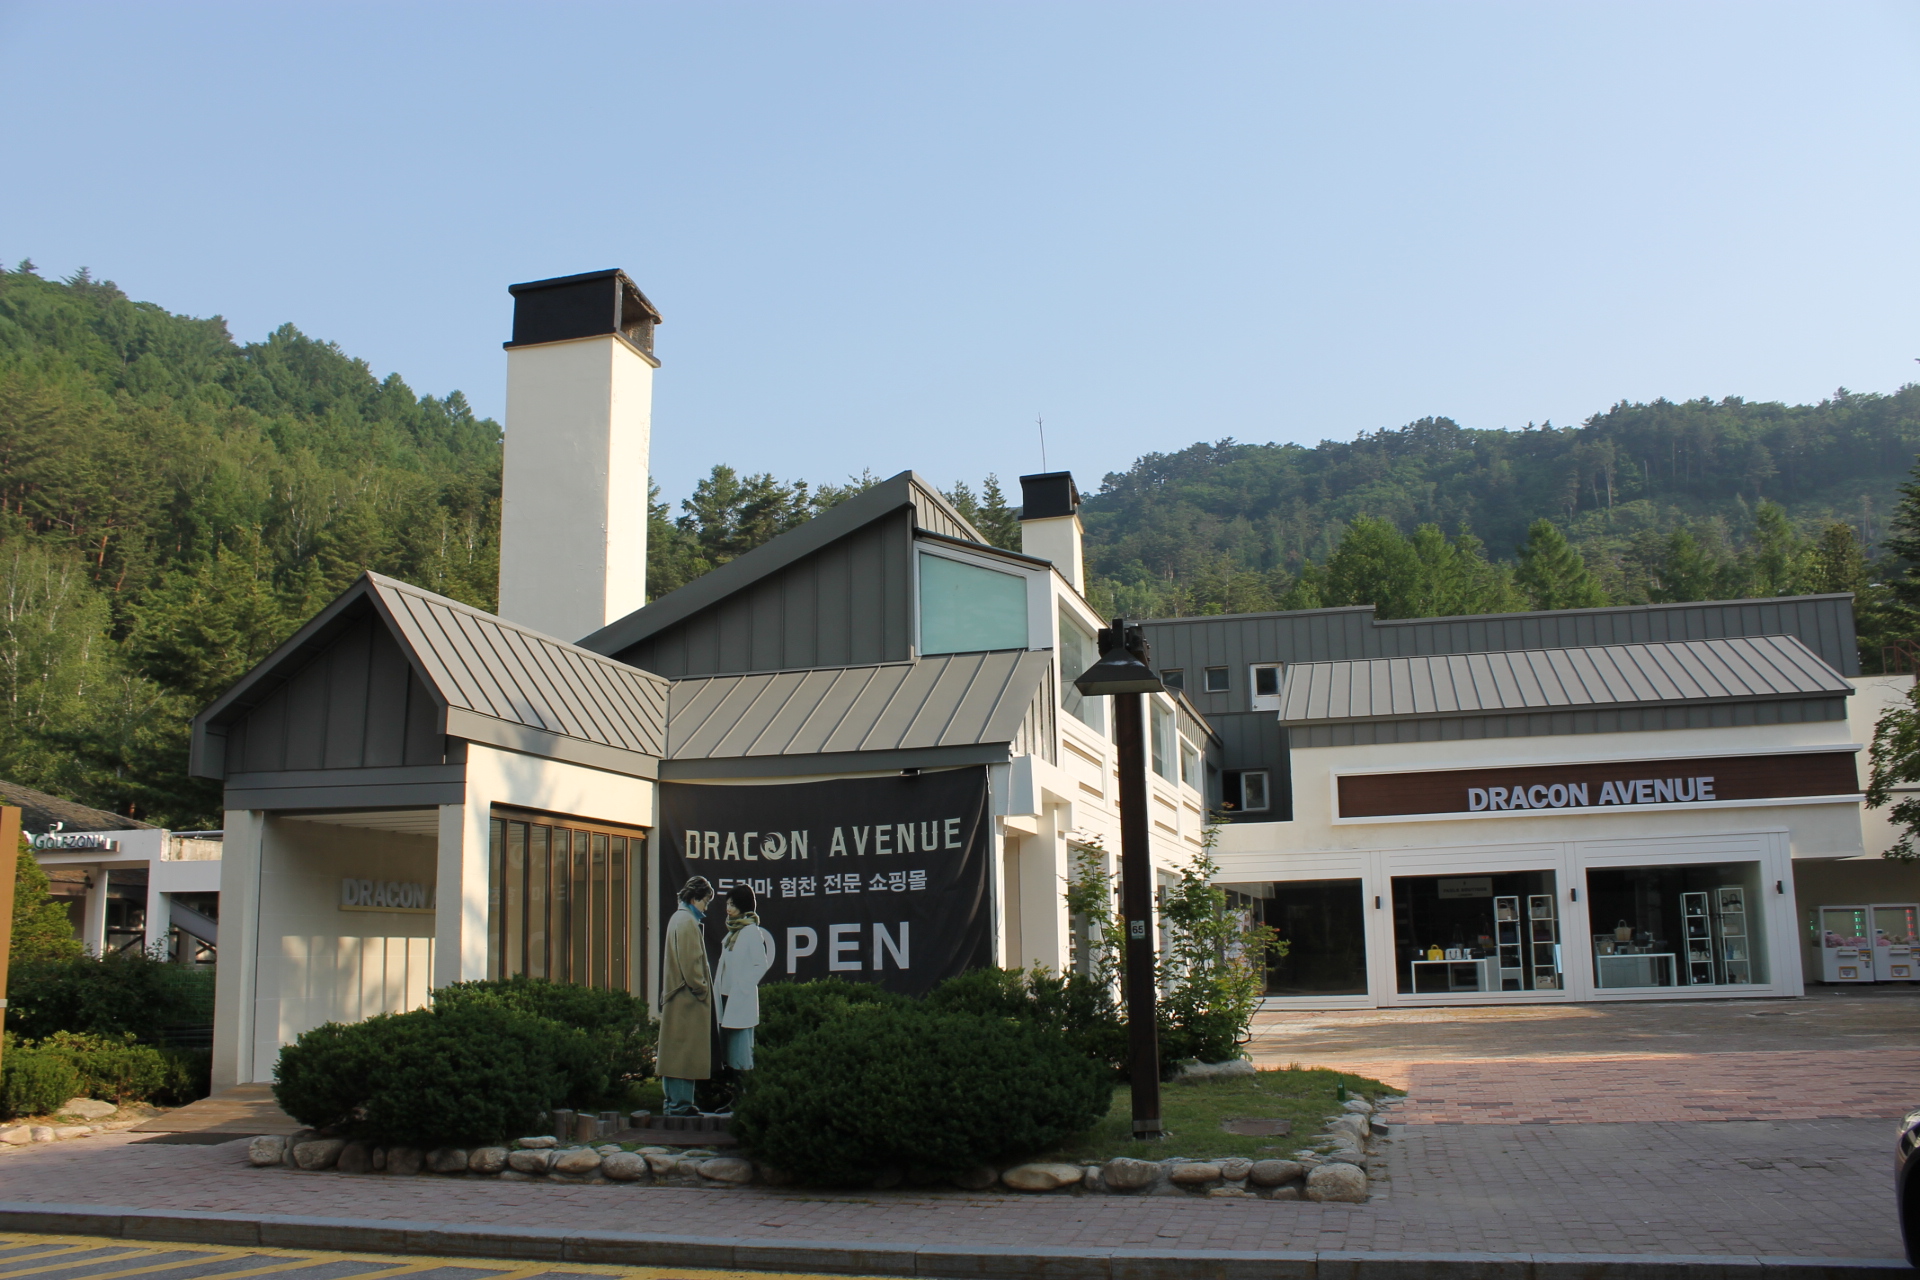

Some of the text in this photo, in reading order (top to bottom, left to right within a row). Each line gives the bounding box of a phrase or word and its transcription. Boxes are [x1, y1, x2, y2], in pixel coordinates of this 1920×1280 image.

[1468, 777, 1716, 812] DRACON AVENUE
[829, 818, 962, 858] AVENUE
[342, 878, 425, 908] DRACON
[779, 876, 817, 898] 협찬
[823, 873, 862, 894] 전문
[868, 869, 928, 892] 쇼핑몰
[1132, 925, 1143, 934] 65
